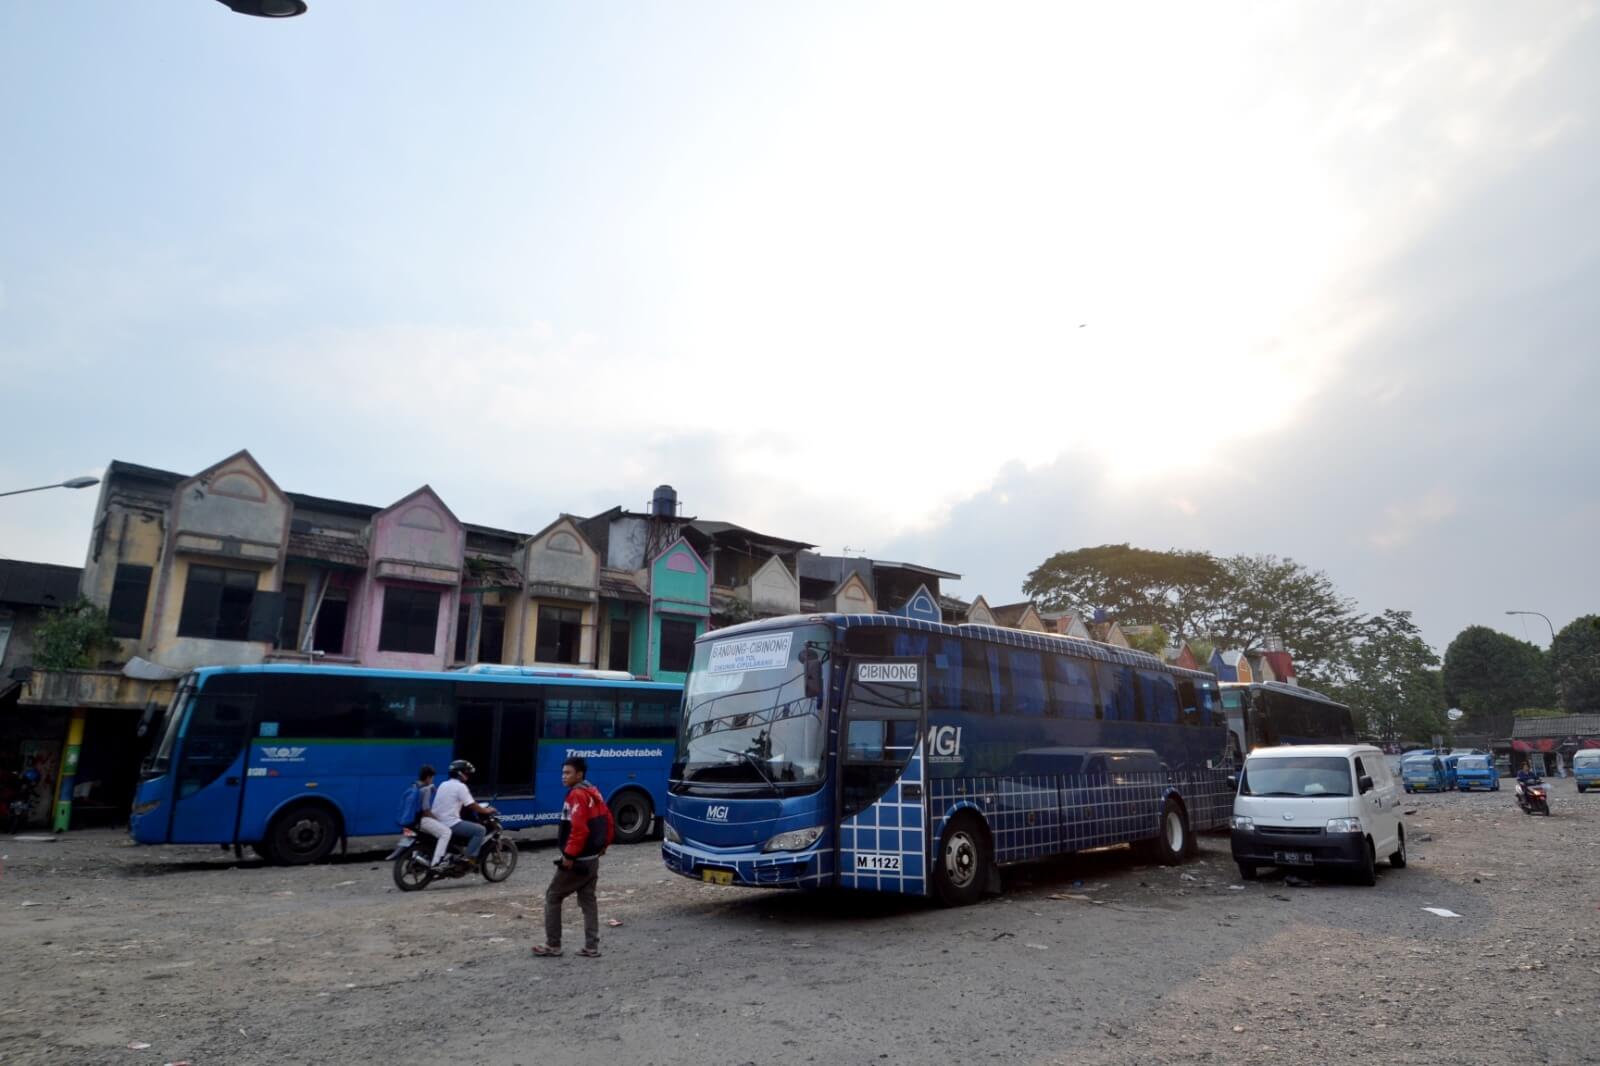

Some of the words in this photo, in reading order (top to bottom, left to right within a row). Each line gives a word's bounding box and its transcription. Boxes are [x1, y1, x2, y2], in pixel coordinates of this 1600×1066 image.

[712, 639, 788, 658] BANDUNG-CIBINONG
[860, 665, 916, 680] CIBINONG
[566, 748, 662, 758] TransJabodetabek
[706, 805, 728, 819] MGI
[857, 856, 867, 867] M
[871, 857, 899, 869] 1122
